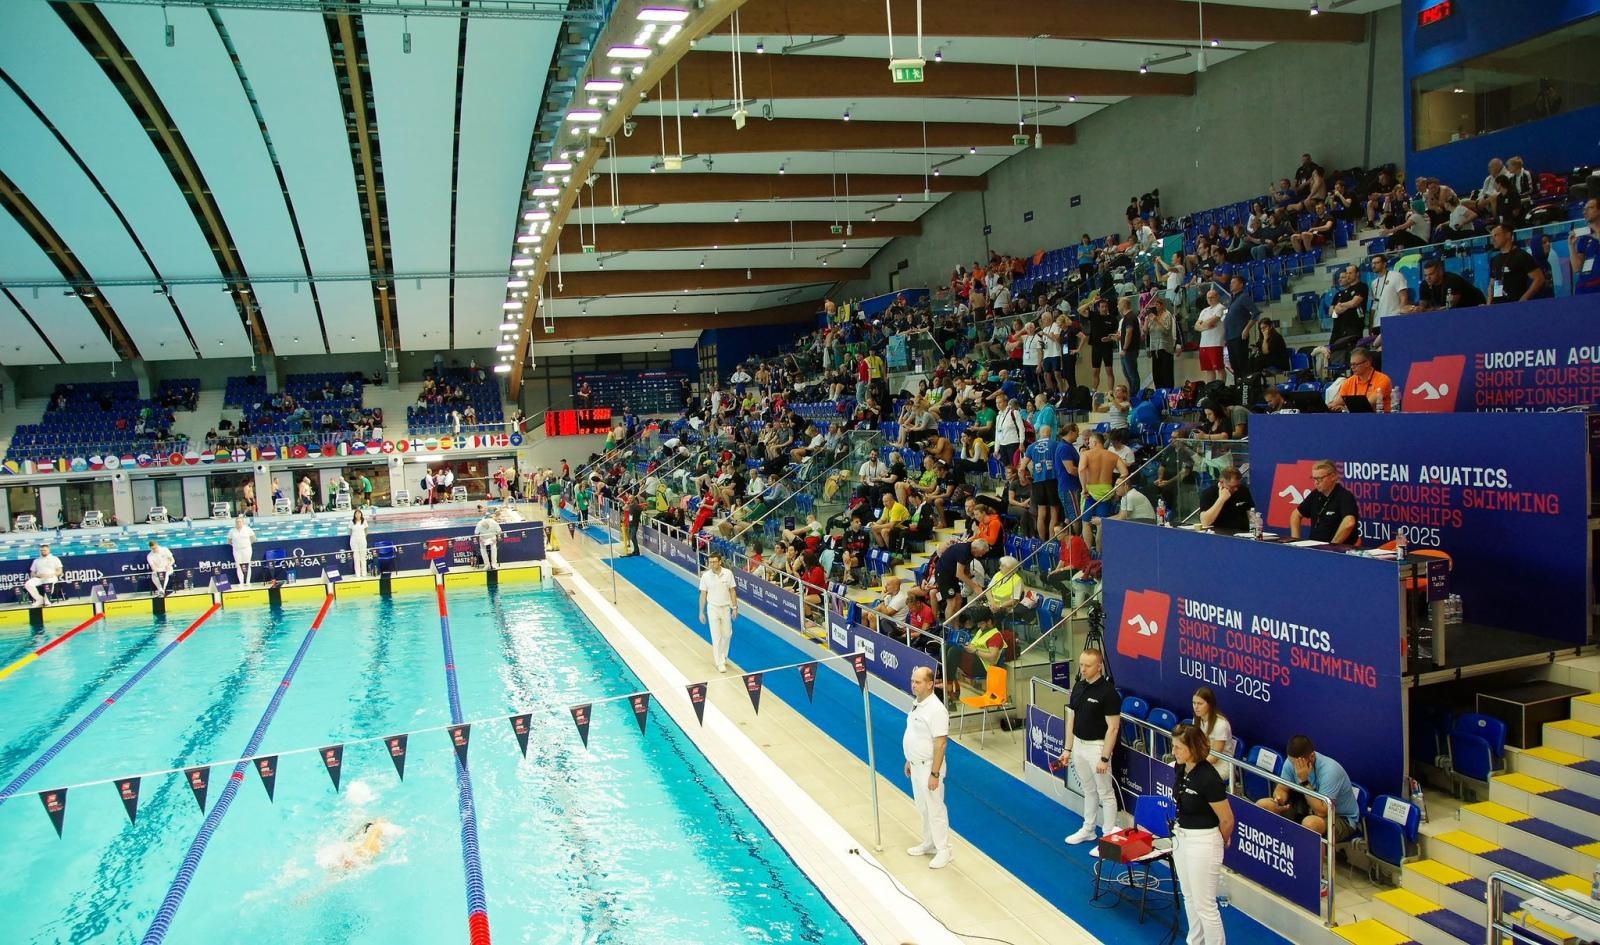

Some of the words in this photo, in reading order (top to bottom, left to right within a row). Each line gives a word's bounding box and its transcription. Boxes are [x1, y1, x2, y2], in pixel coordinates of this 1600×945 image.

[1475, 349, 1556, 369] EUROPEAN
[1568, 346, 1600, 364] AQU
[1475, 370, 1524, 388] SHORT
[1535, 366, 1600, 385] COURSE
[1475, 386, 1600, 406] CHAMPIONSHIP
[1335, 461, 1409, 482] EUROPEAN
[1341, 482, 1381, 500] HORT
[1391, 484, 1450, 506] COURSE
[1463, 489, 1559, 514] SWIMMING
[1357, 501, 1462, 528] AMPIONSHIPS
[1178, 597, 1242, 630] EUROPEAN
[1178, 619, 1218, 643] SHORT
[1226, 630, 1280, 662] COURSE
[1290, 648, 1376, 688] SWIMMING
[1179, 637, 1291, 687] CHAMPIONSHIPS
[1238, 821, 1294, 861] EUROPEAN
